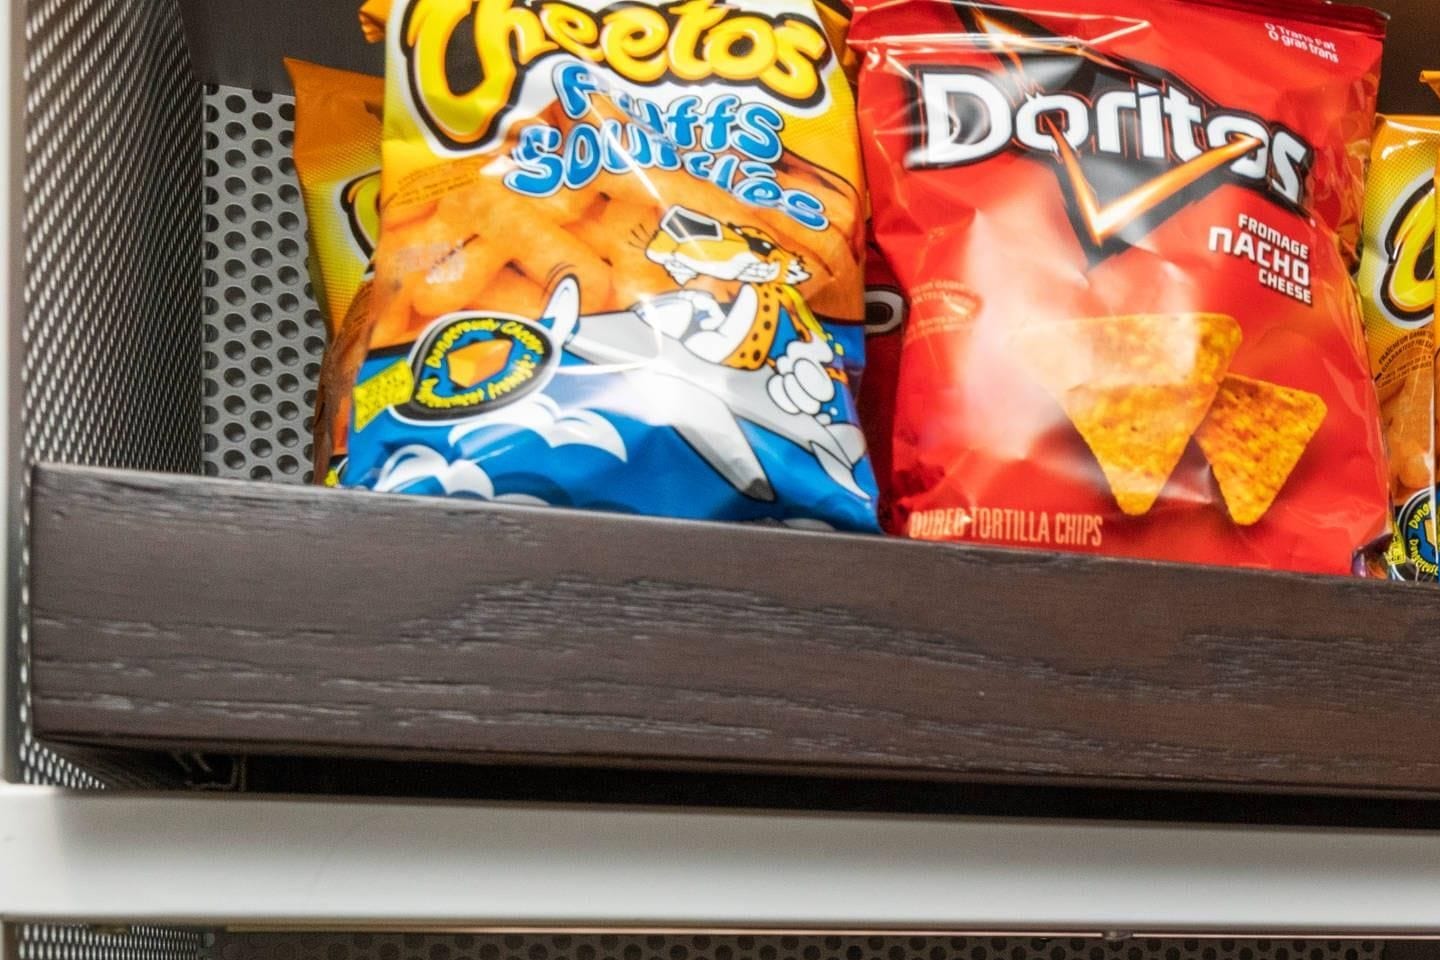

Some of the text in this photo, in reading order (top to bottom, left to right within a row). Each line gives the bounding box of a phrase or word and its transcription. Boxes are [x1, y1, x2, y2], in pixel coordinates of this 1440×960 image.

[403, 0, 826, 152] Cheetos
[904, 71, 1310, 206] Doritos
[1238, 213, 1309, 259] FROMAGE
[1257, 268, 1313, 304] CHEESE
[969, 506, 1050, 543] TORTILLA
[1054, 512, 1104, 546] CHIPS
